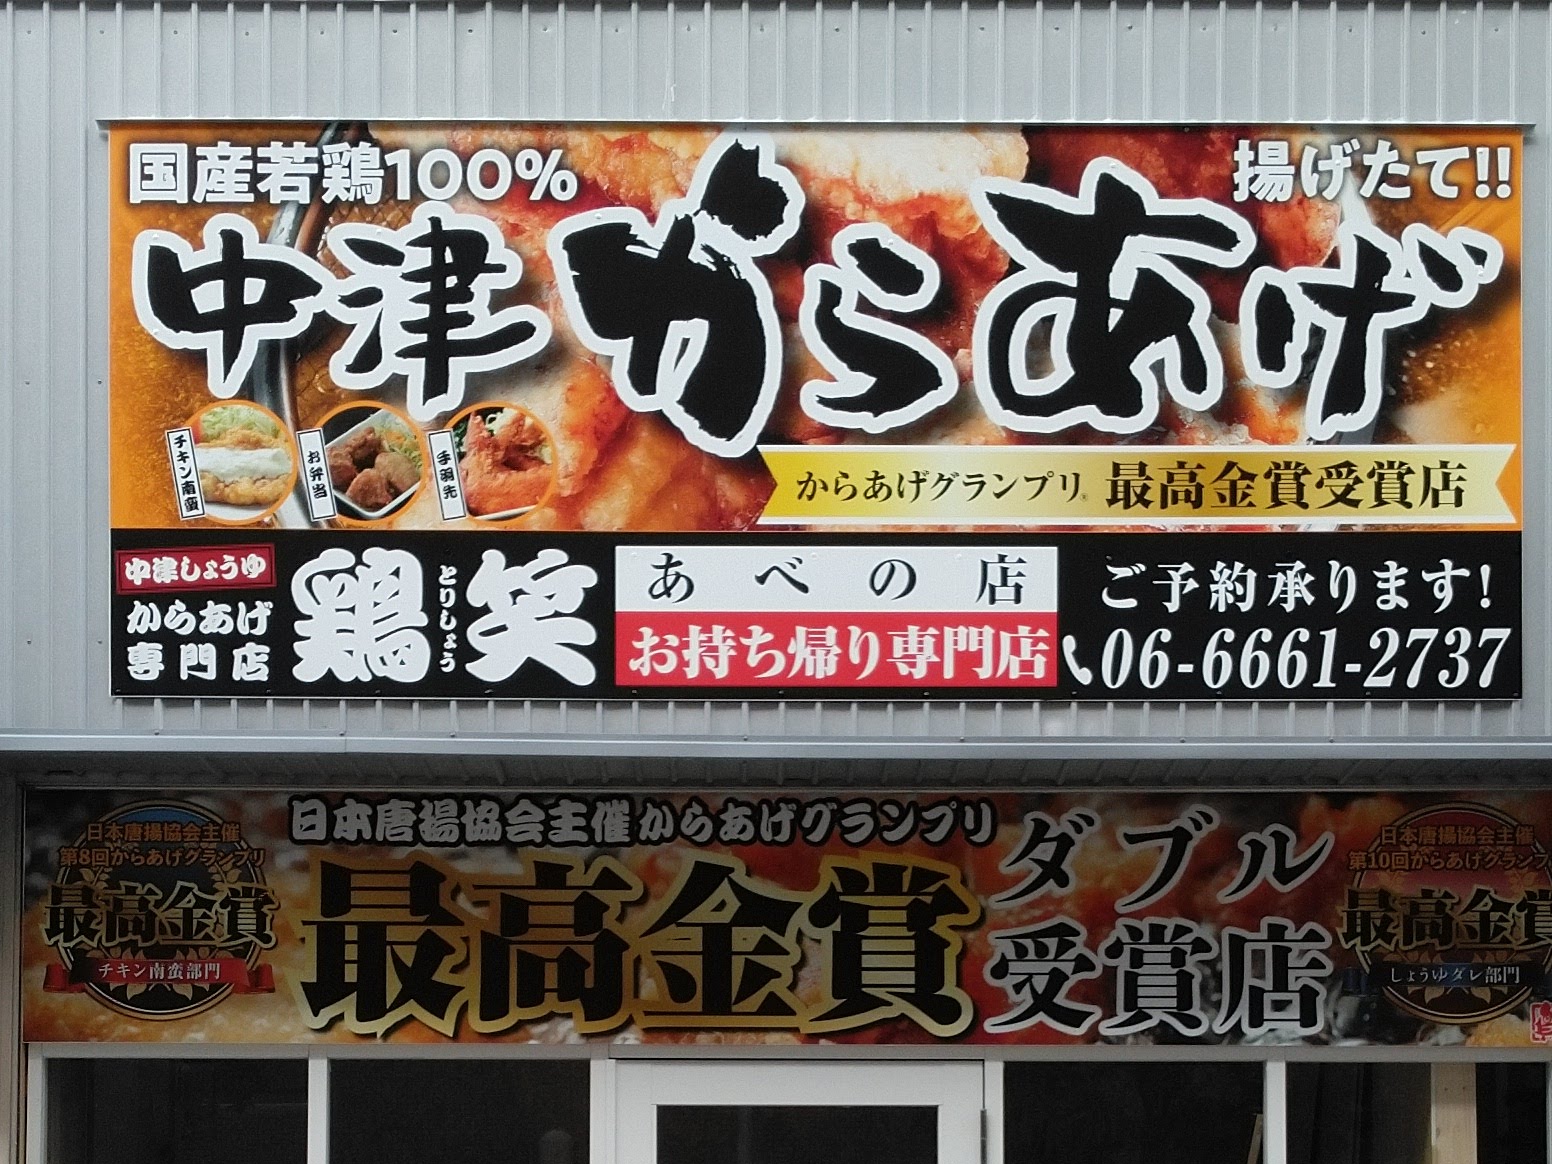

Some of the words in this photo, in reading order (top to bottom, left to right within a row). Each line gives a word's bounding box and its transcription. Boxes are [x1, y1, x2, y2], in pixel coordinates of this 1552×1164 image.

[128, 141, 579, 205] 国産若鶏100%
[173, 436, 200, 512] チキン南蛮
[307, 451, 328, 498] お弁当
[437, 450, 458, 499] 手羽先
[1106, 461, 1467, 510] 最高金賞受賞店
[125, 553, 267, 586] 中津しょうゆ
[649, 552, 1028, 606] あべの店
[127, 600, 271, 636] からあげ
[290, 546, 599, 687] 鶏笑
[439, 565, 457, 673] とりしょう
[127, 642, 271, 683] 専門店
[628, 624, 1050, 680] お持ち帰り専門店
[1100, 627, 1513, 690] 06-6661-2737
[87, 822, 240, 842] 日本唐揚協会主催
[986, 806, 1334, 912] ダブル
[1381, 825, 1535, 845] 日本唐揚協会主催
[42, 882, 279, 947] 最高金賞
[98, 962, 221, 980] チキン南蛮部門
[298, 855, 974, 1035] 最高金賞
[984, 918, 1334, 1036] 受賞店
